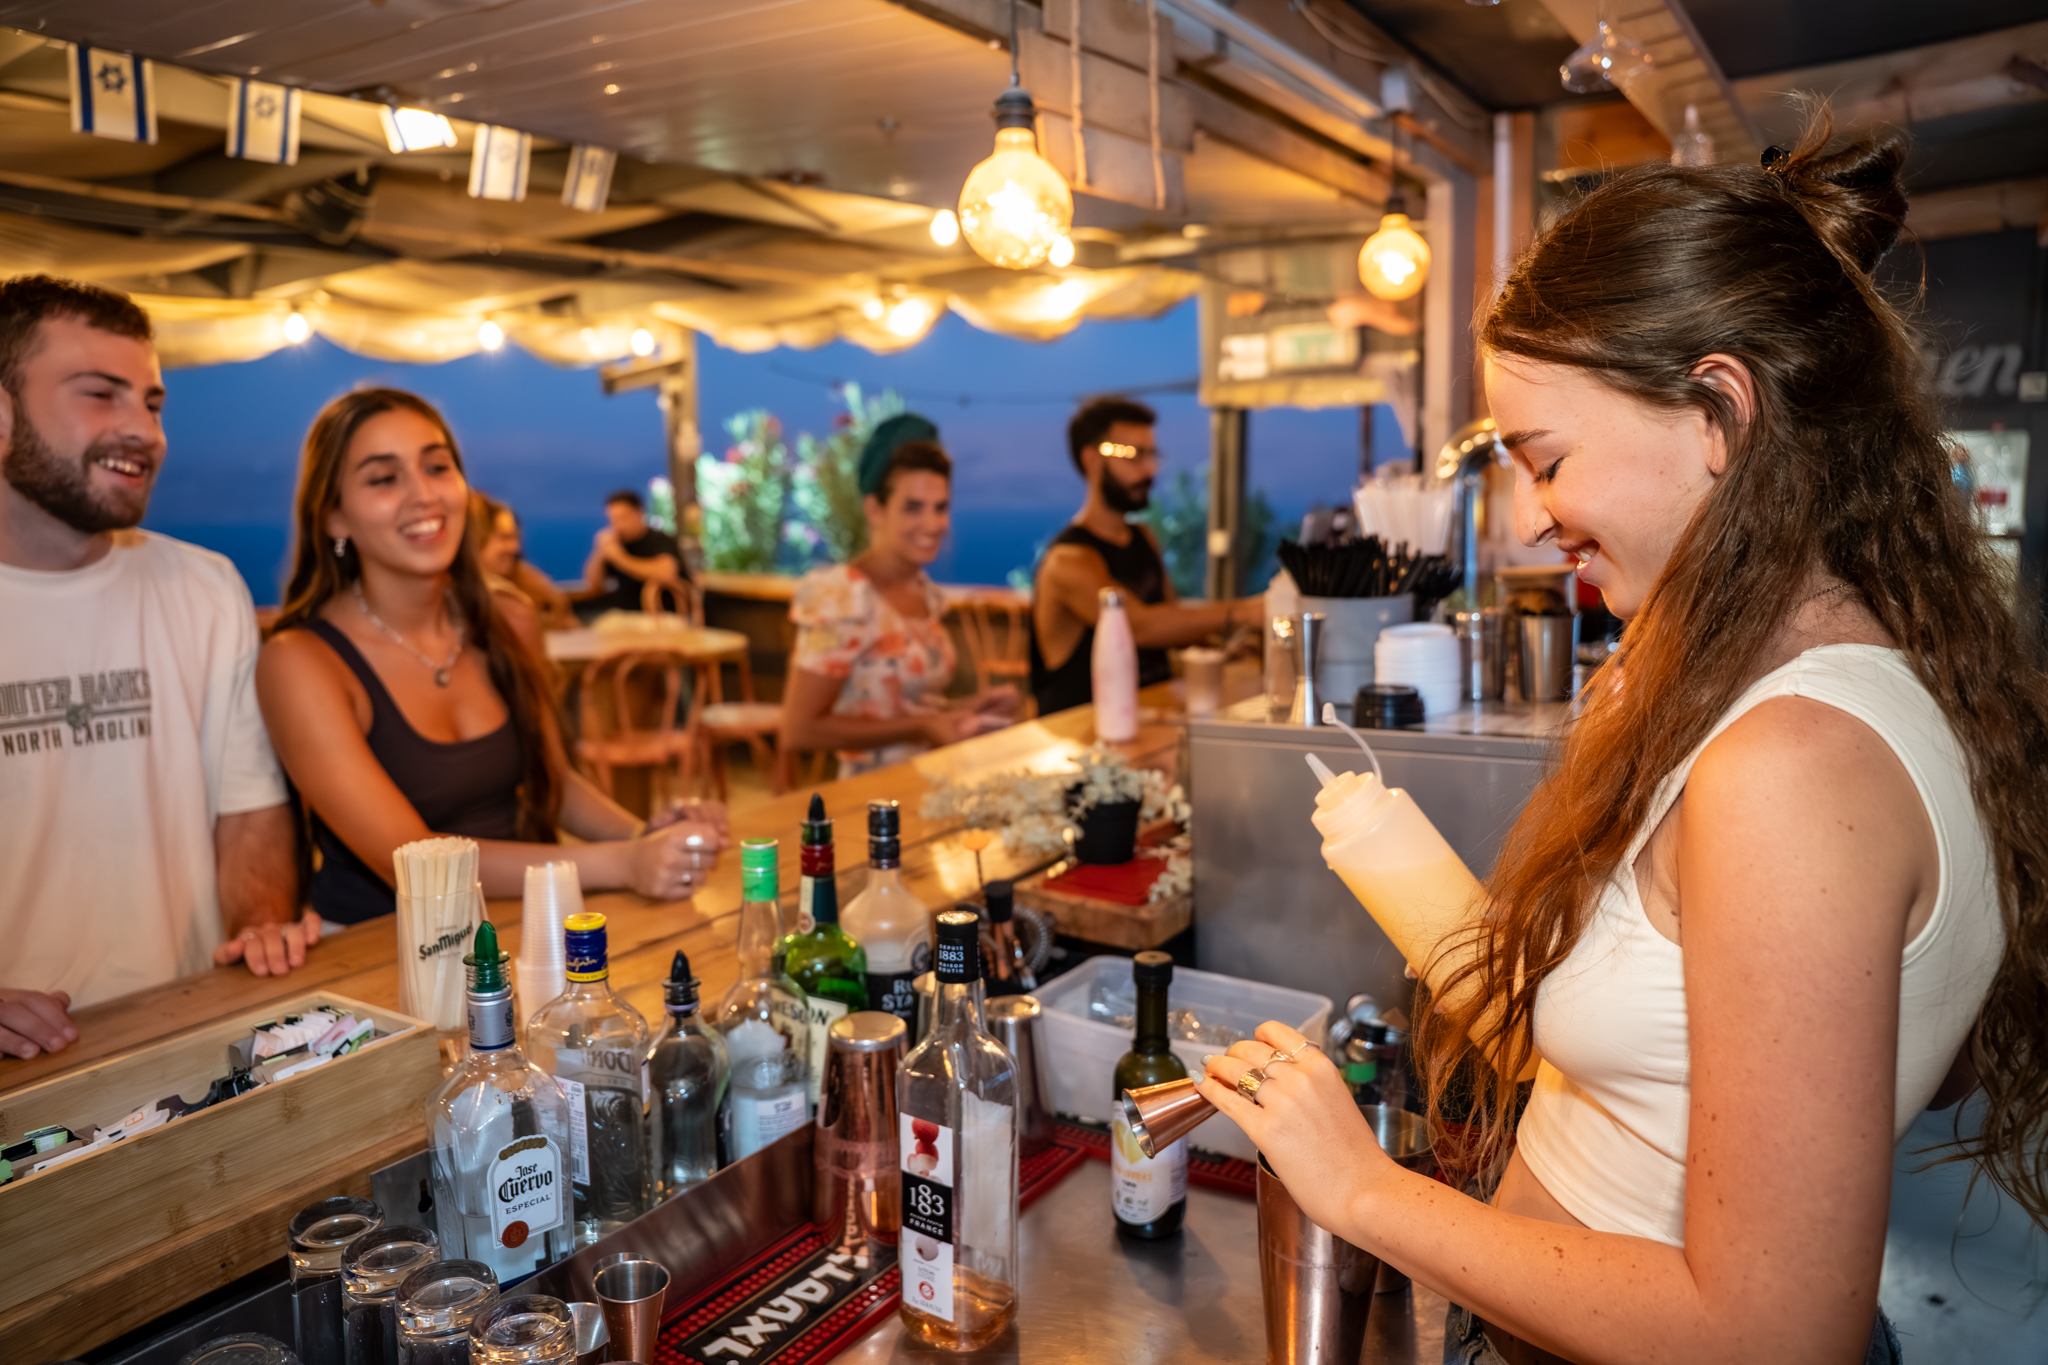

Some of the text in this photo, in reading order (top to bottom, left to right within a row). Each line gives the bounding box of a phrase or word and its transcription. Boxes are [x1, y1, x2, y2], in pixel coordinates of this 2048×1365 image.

[2, 717, 151, 757] NORTH CAROLIN
[939, 949, 965, 961] 1883
[514, 1163, 538, 1180] Jose
[498, 1170, 553, 1203] Cuervo
[505, 1194, 551, 1215] ESPECIAL
[909, 1217, 944, 1236] FRANCE
